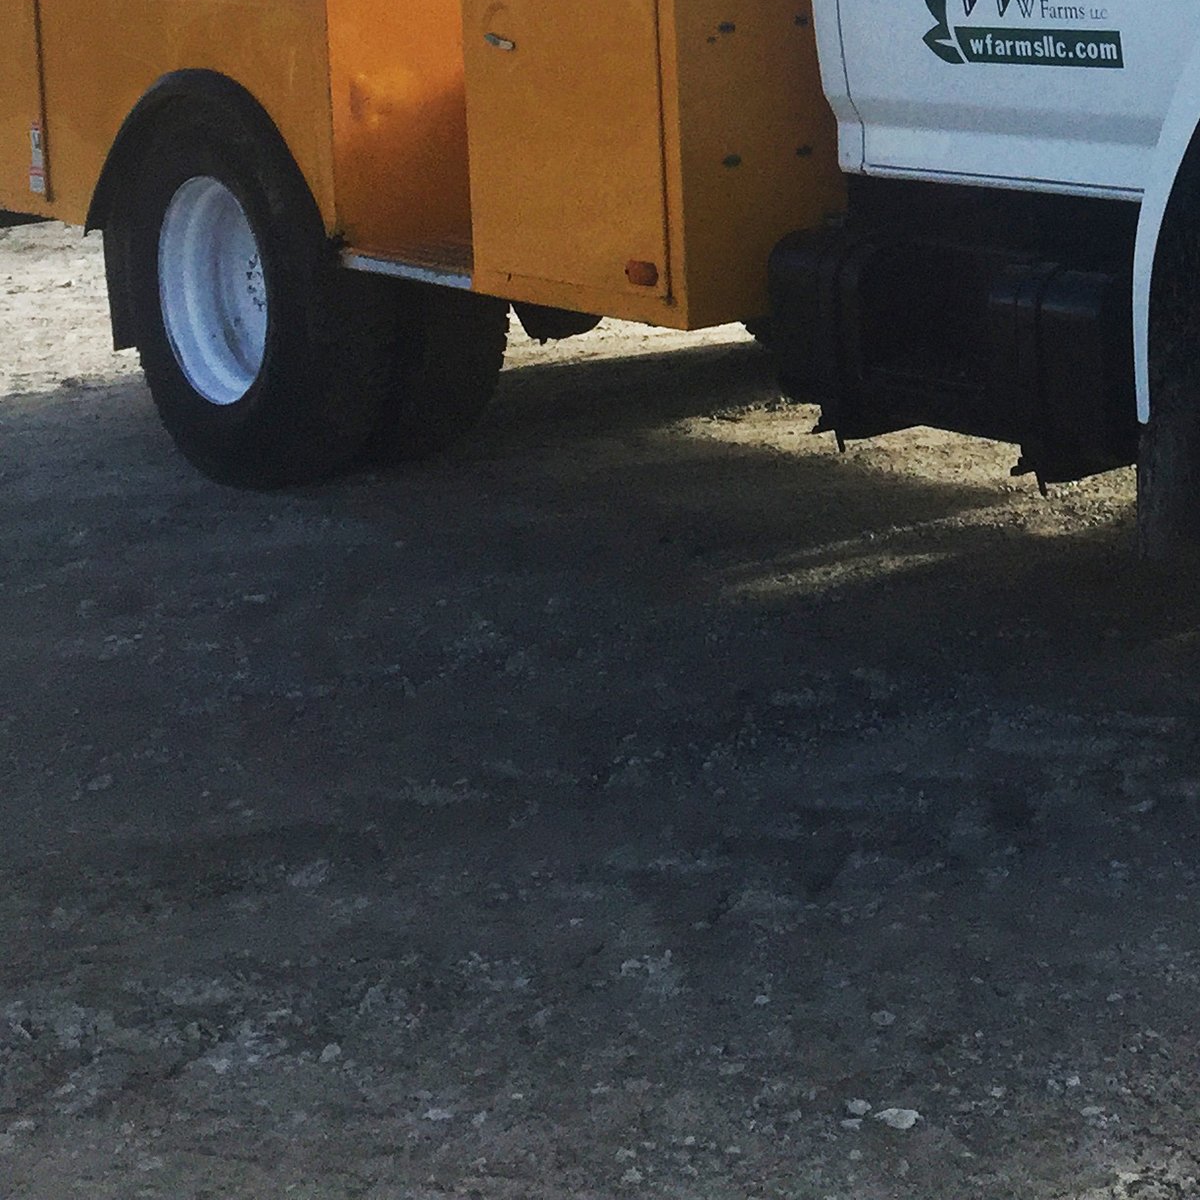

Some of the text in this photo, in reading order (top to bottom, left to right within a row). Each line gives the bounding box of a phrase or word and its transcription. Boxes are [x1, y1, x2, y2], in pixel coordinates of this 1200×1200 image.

[1016, 0, 1035, 19] W
[1040, 0, 1086, 20] Farms
[969, 33, 1118, 60] wfarmsllc.com
